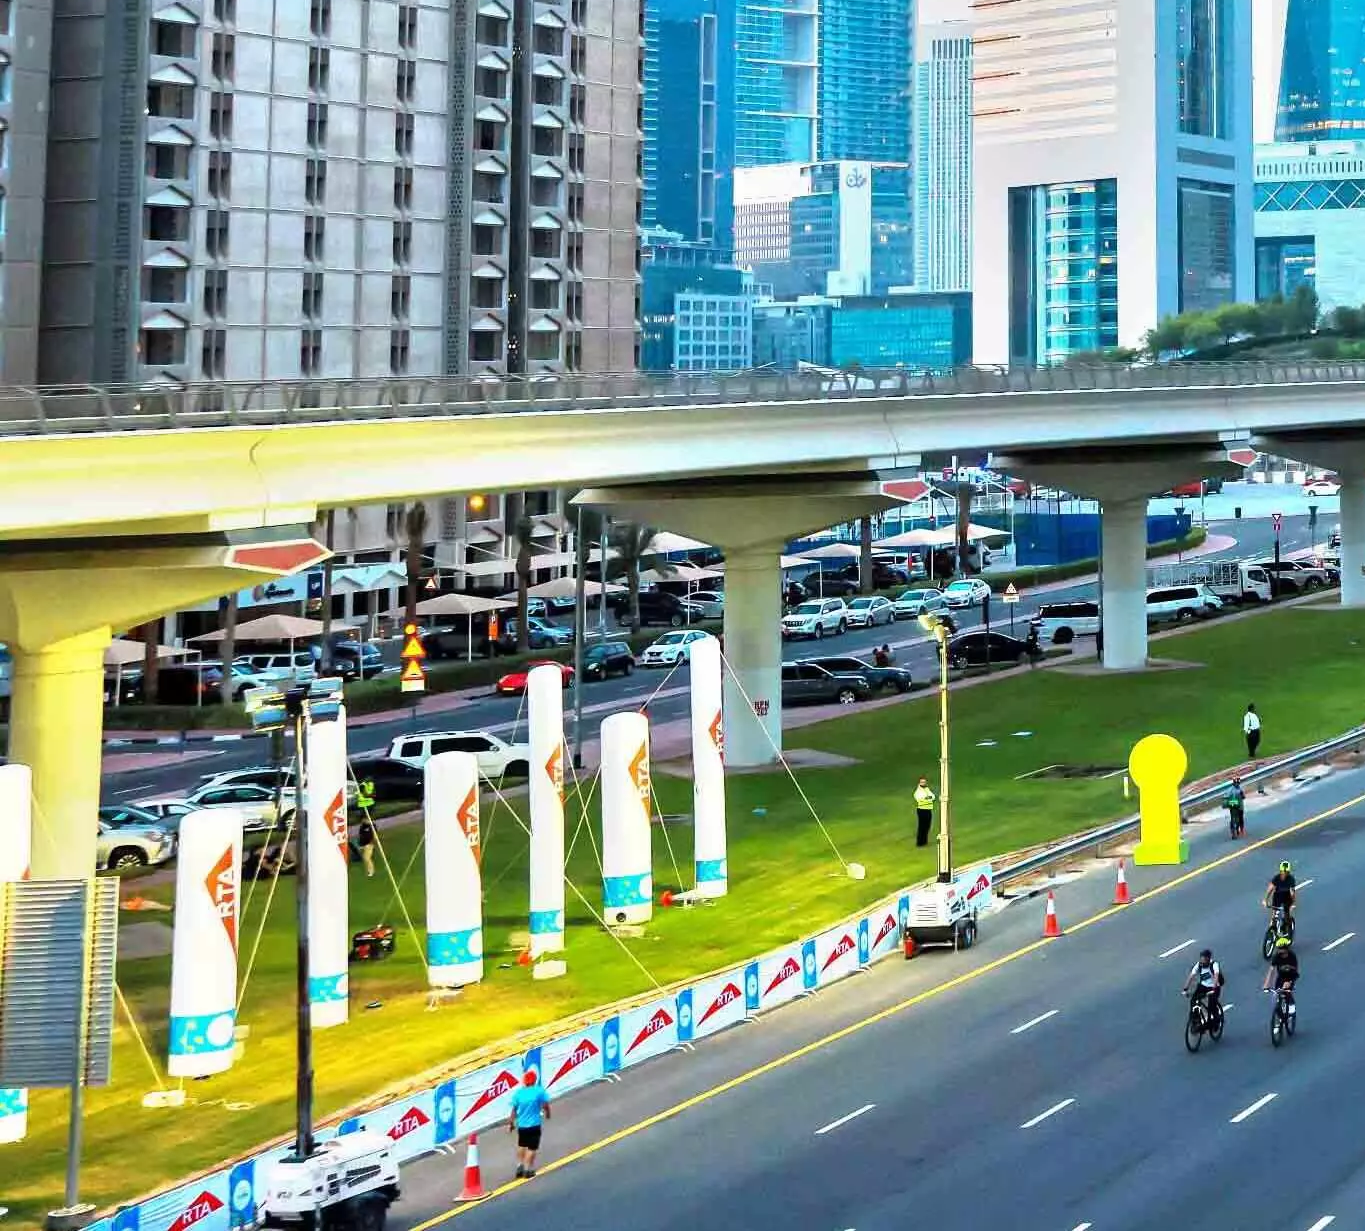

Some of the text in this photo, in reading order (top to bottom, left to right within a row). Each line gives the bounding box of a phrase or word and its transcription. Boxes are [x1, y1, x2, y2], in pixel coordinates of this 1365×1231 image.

[466, 801, 480, 847] RTA
[216, 866, 235, 919] RTA
[835, 942, 851, 954] RTA
[779, 964, 796, 979] RTA
[717, 990, 736, 1006] RTA
[648, 1015, 667, 1033] RTA
[569, 1047, 591, 1067] RTA
[486, 1079, 510, 1099] RTA
[393, 1115, 420, 1135] RTA
[181, 1200, 211, 1225] RTA
